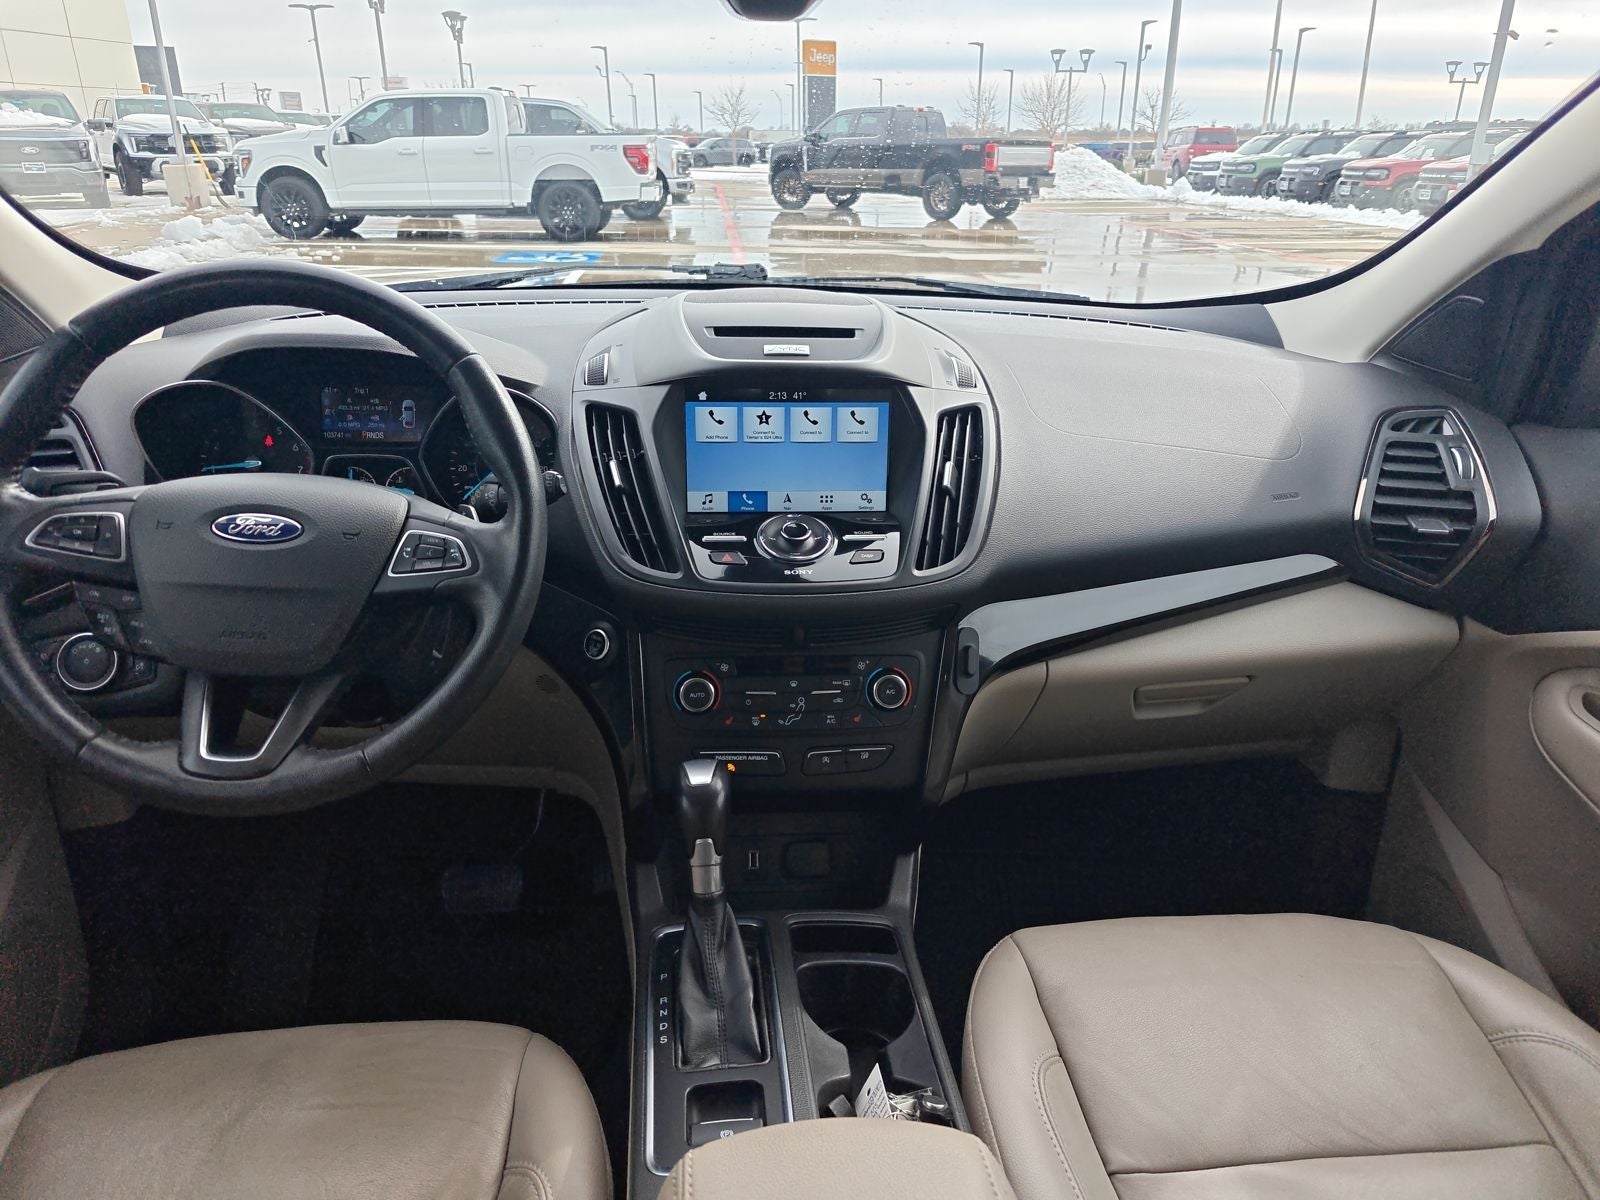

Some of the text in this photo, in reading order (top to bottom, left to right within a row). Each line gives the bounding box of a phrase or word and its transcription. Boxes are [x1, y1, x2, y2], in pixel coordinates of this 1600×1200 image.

[810, 48, 834, 65] Jeep
[590, 144, 618, 152] FX4
[769, 391, 807, 400] 2:13 41°
[292, 443, 299, 452] 6
[297, 465, 304, 475] 7
[458, 464, 468, 472] 20
[228, 516, 285, 537] Ford
[660, 973, 668, 1044] P R N D S
